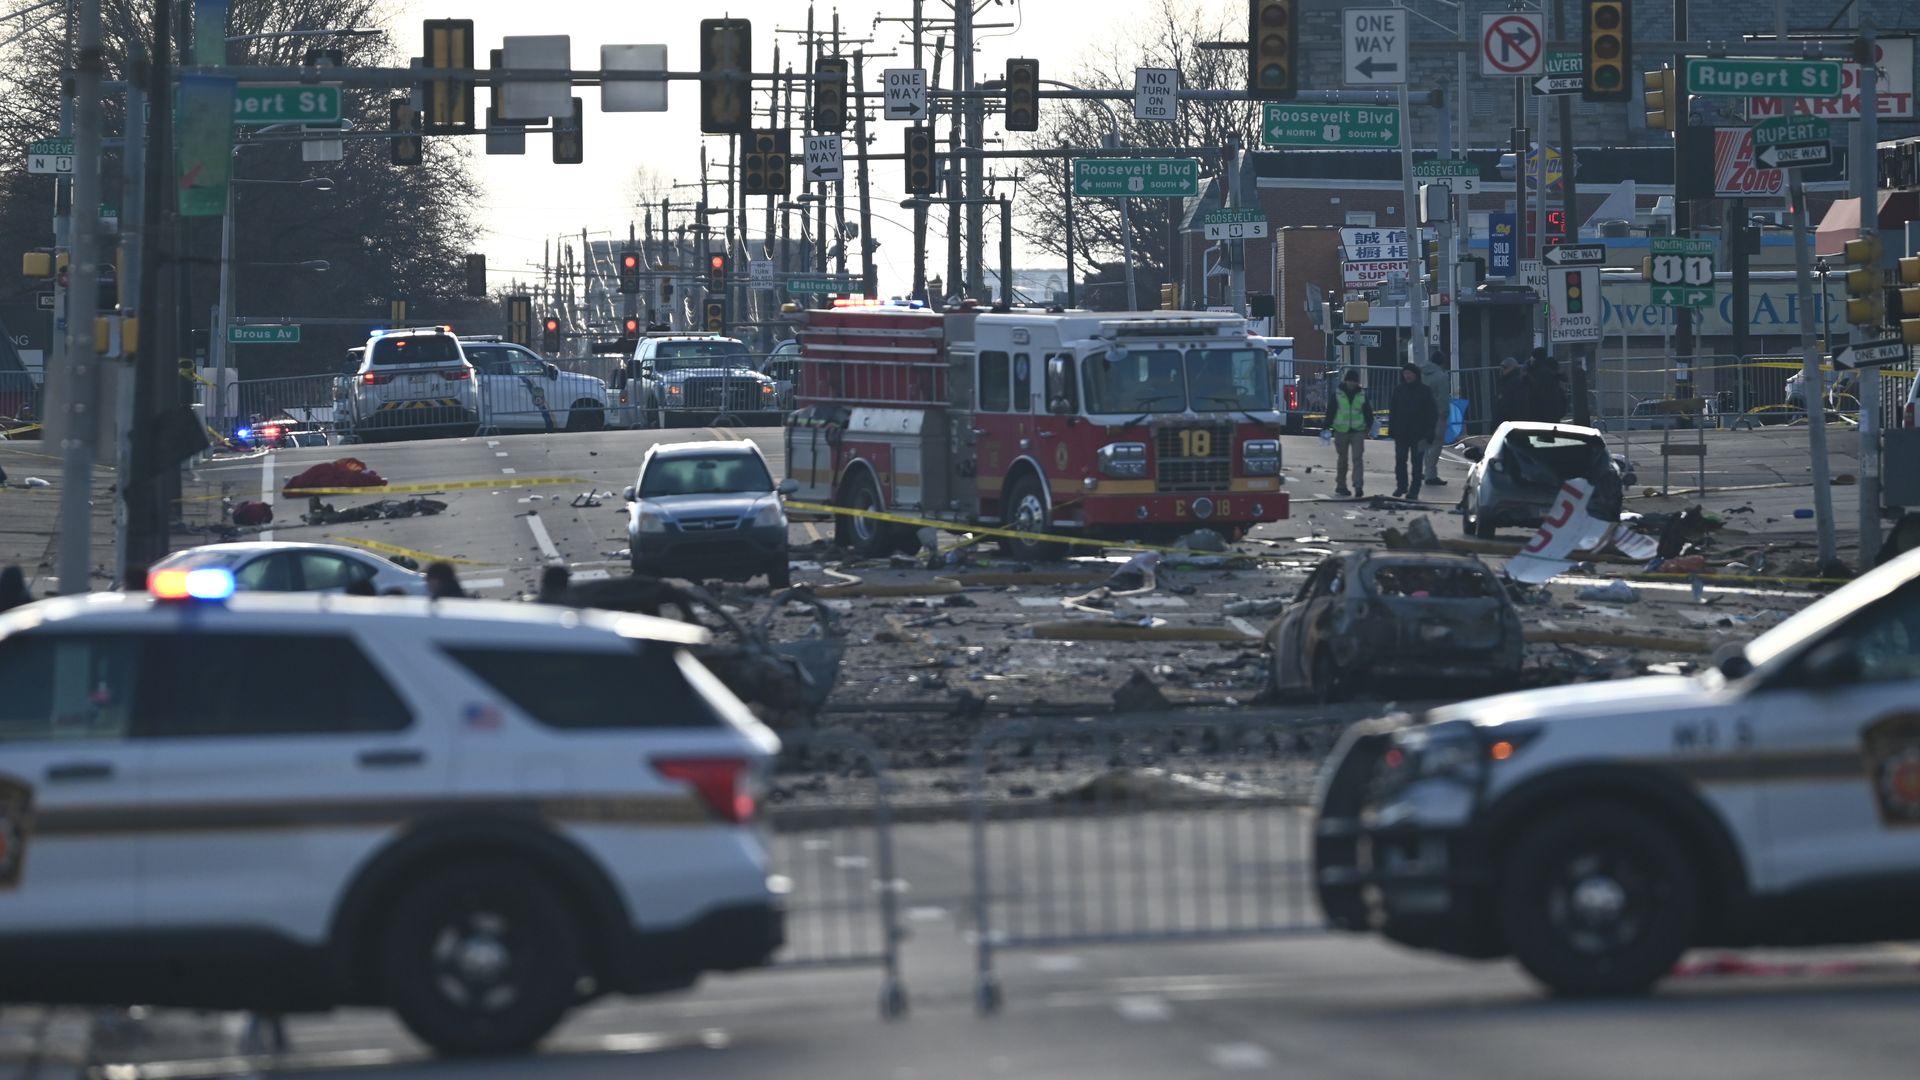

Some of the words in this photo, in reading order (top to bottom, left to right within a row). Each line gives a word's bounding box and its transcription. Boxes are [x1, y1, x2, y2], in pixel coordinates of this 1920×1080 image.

[1356, 15, 1395, 33] ONE
[1355, 36, 1396, 53] WAY
[890, 74, 921, 86] ONE
[1146, 73, 1167, 85] NO
[1550, 80, 1568, 88] ONE
[1570, 79, 1583, 88] WA
[1699, 66, 1789, 90] Rupert
[1802, 67, 1829, 87] St
[890, 87, 922, 99] WAY
[1142, 86, 1170, 96] TURN
[299, 91, 328, 113] St
[1148, 97, 1164, 106] ON
[1751, 93, 1912, 115] MARKET
[1145, 107, 1166, 116] RED
[1270, 108, 1351, 124] Roosevelt
[1357, 111, 1394, 125] Blvd
[1286, 129, 1317, 137] NORTH
[1348, 130, 1378, 138] SOUTH
[1756, 124, 1815, 143] RUPERT
[1816, 127, 1828, 138] ST
[809, 139, 837, 151] ONE
[809, 151, 838, 164] WAY
[1777, 150, 1798, 161] ONE
[1800, 148, 1824, 158] WAY
[35, 158, 45, 169] N
[1080, 163, 1153, 175] Roosevelt
[1159, 163, 1191, 175] Blvd
[1411, 165, 1463, 176] ROOSEVELT
[1725, 161, 1784, 192] Zone
[1464, 180, 1473, 190] S
[1205, 212, 1251, 223] ROOSEVELT
[1211, 227, 1220, 236] N
[1254, 225, 1261, 234] S
[1493, 242, 1510, 254] SOLD
[1654, 240, 1683, 250] NORTH
[1561, 251, 1578, 260] ONE
[1581, 249, 1600, 259] WAY
[1345, 261, 1409, 271] INTEGRIT
[1493, 256, 1510, 267] HERE
[1520, 263, 1537, 271] LEFT
[1662, 259, 1672, 279] 1
[1692, 260, 1700, 281] 1
[1560, 316, 1591, 325] PHOTO
[234, 328, 271, 339] Brous
[277, 328, 292, 339] Av
[1552, 328, 1600, 338] ENFORCED
[1854, 348, 1876, 361] ONE
[1878, 345, 1900, 358] WAY
[1178, 429, 1211, 457] 18
[1175, 499, 1186, 517] E
[1216, 499, 1231, 516] 18
